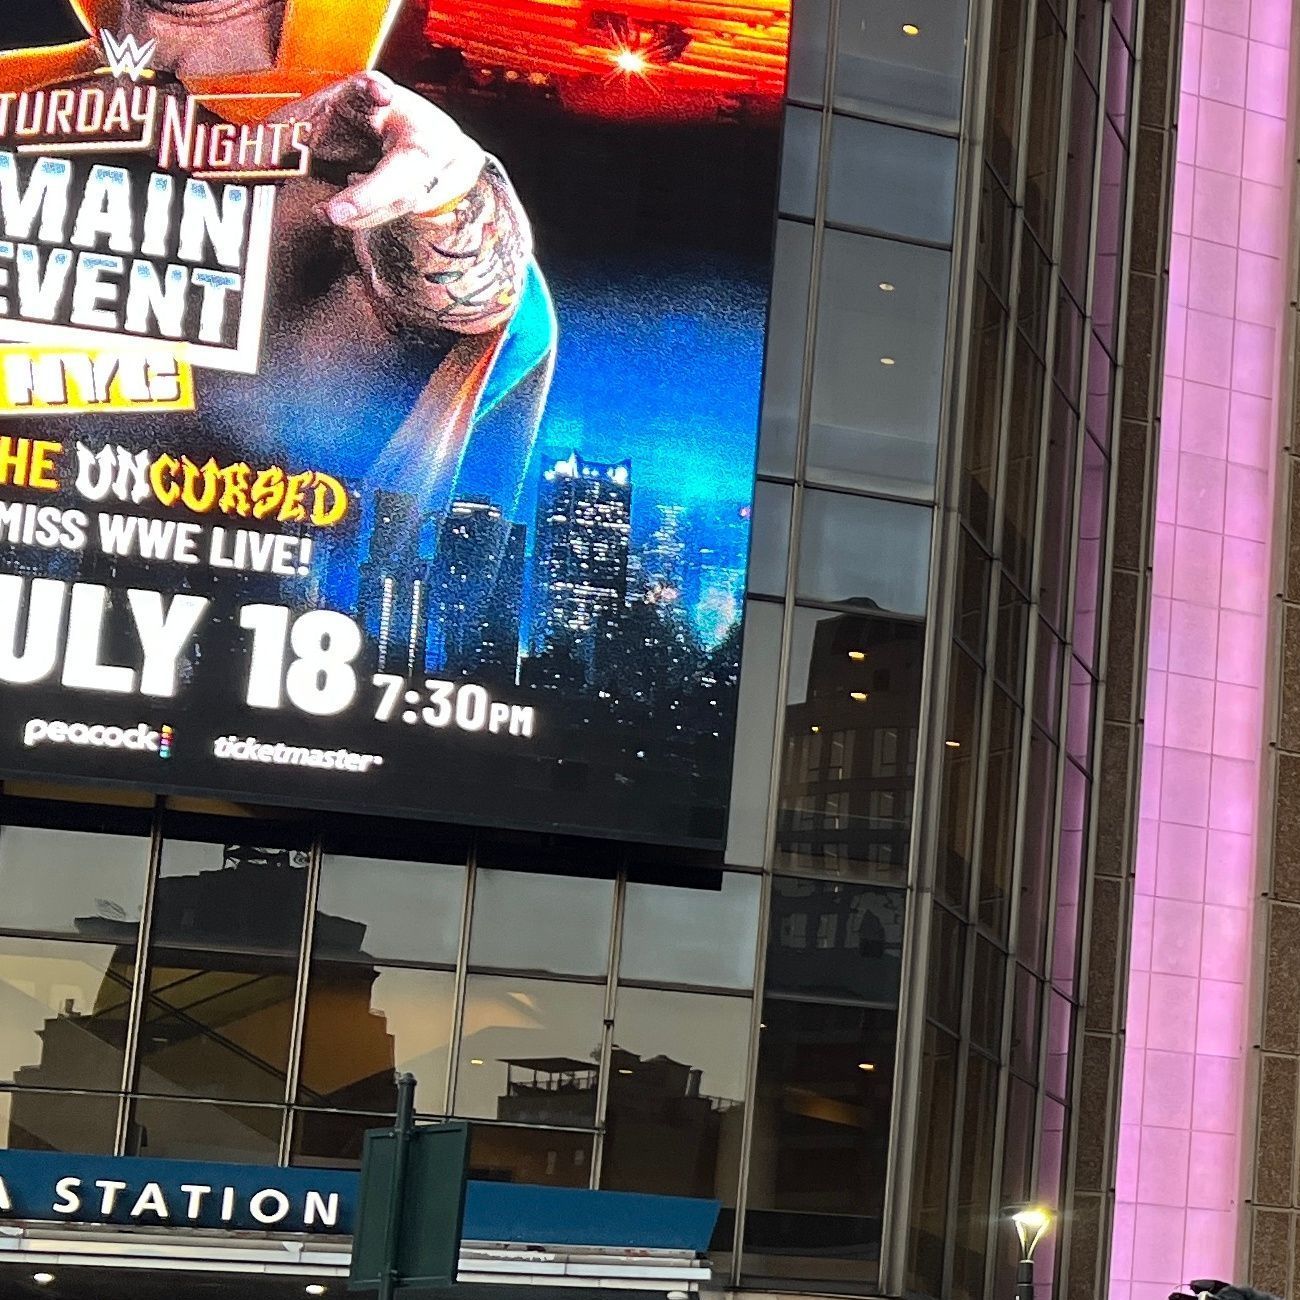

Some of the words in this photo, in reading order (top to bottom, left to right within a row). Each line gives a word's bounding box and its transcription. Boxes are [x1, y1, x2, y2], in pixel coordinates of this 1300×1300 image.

[158, 93, 312, 177] NIGHT'S
[0, 150, 248, 268] MAIN
[75, 440, 348, 526] UNCURSED
[0, 503, 89, 549] MISS
[98, 512, 202, 564] WWE
[209, 526, 313, 576] LIVE!
[240, 603, 364, 716] 18
[23, 717, 161, 753] peacock
[213, 735, 383, 773] ticketmaster
[52, 1176, 339, 1227] STATION
